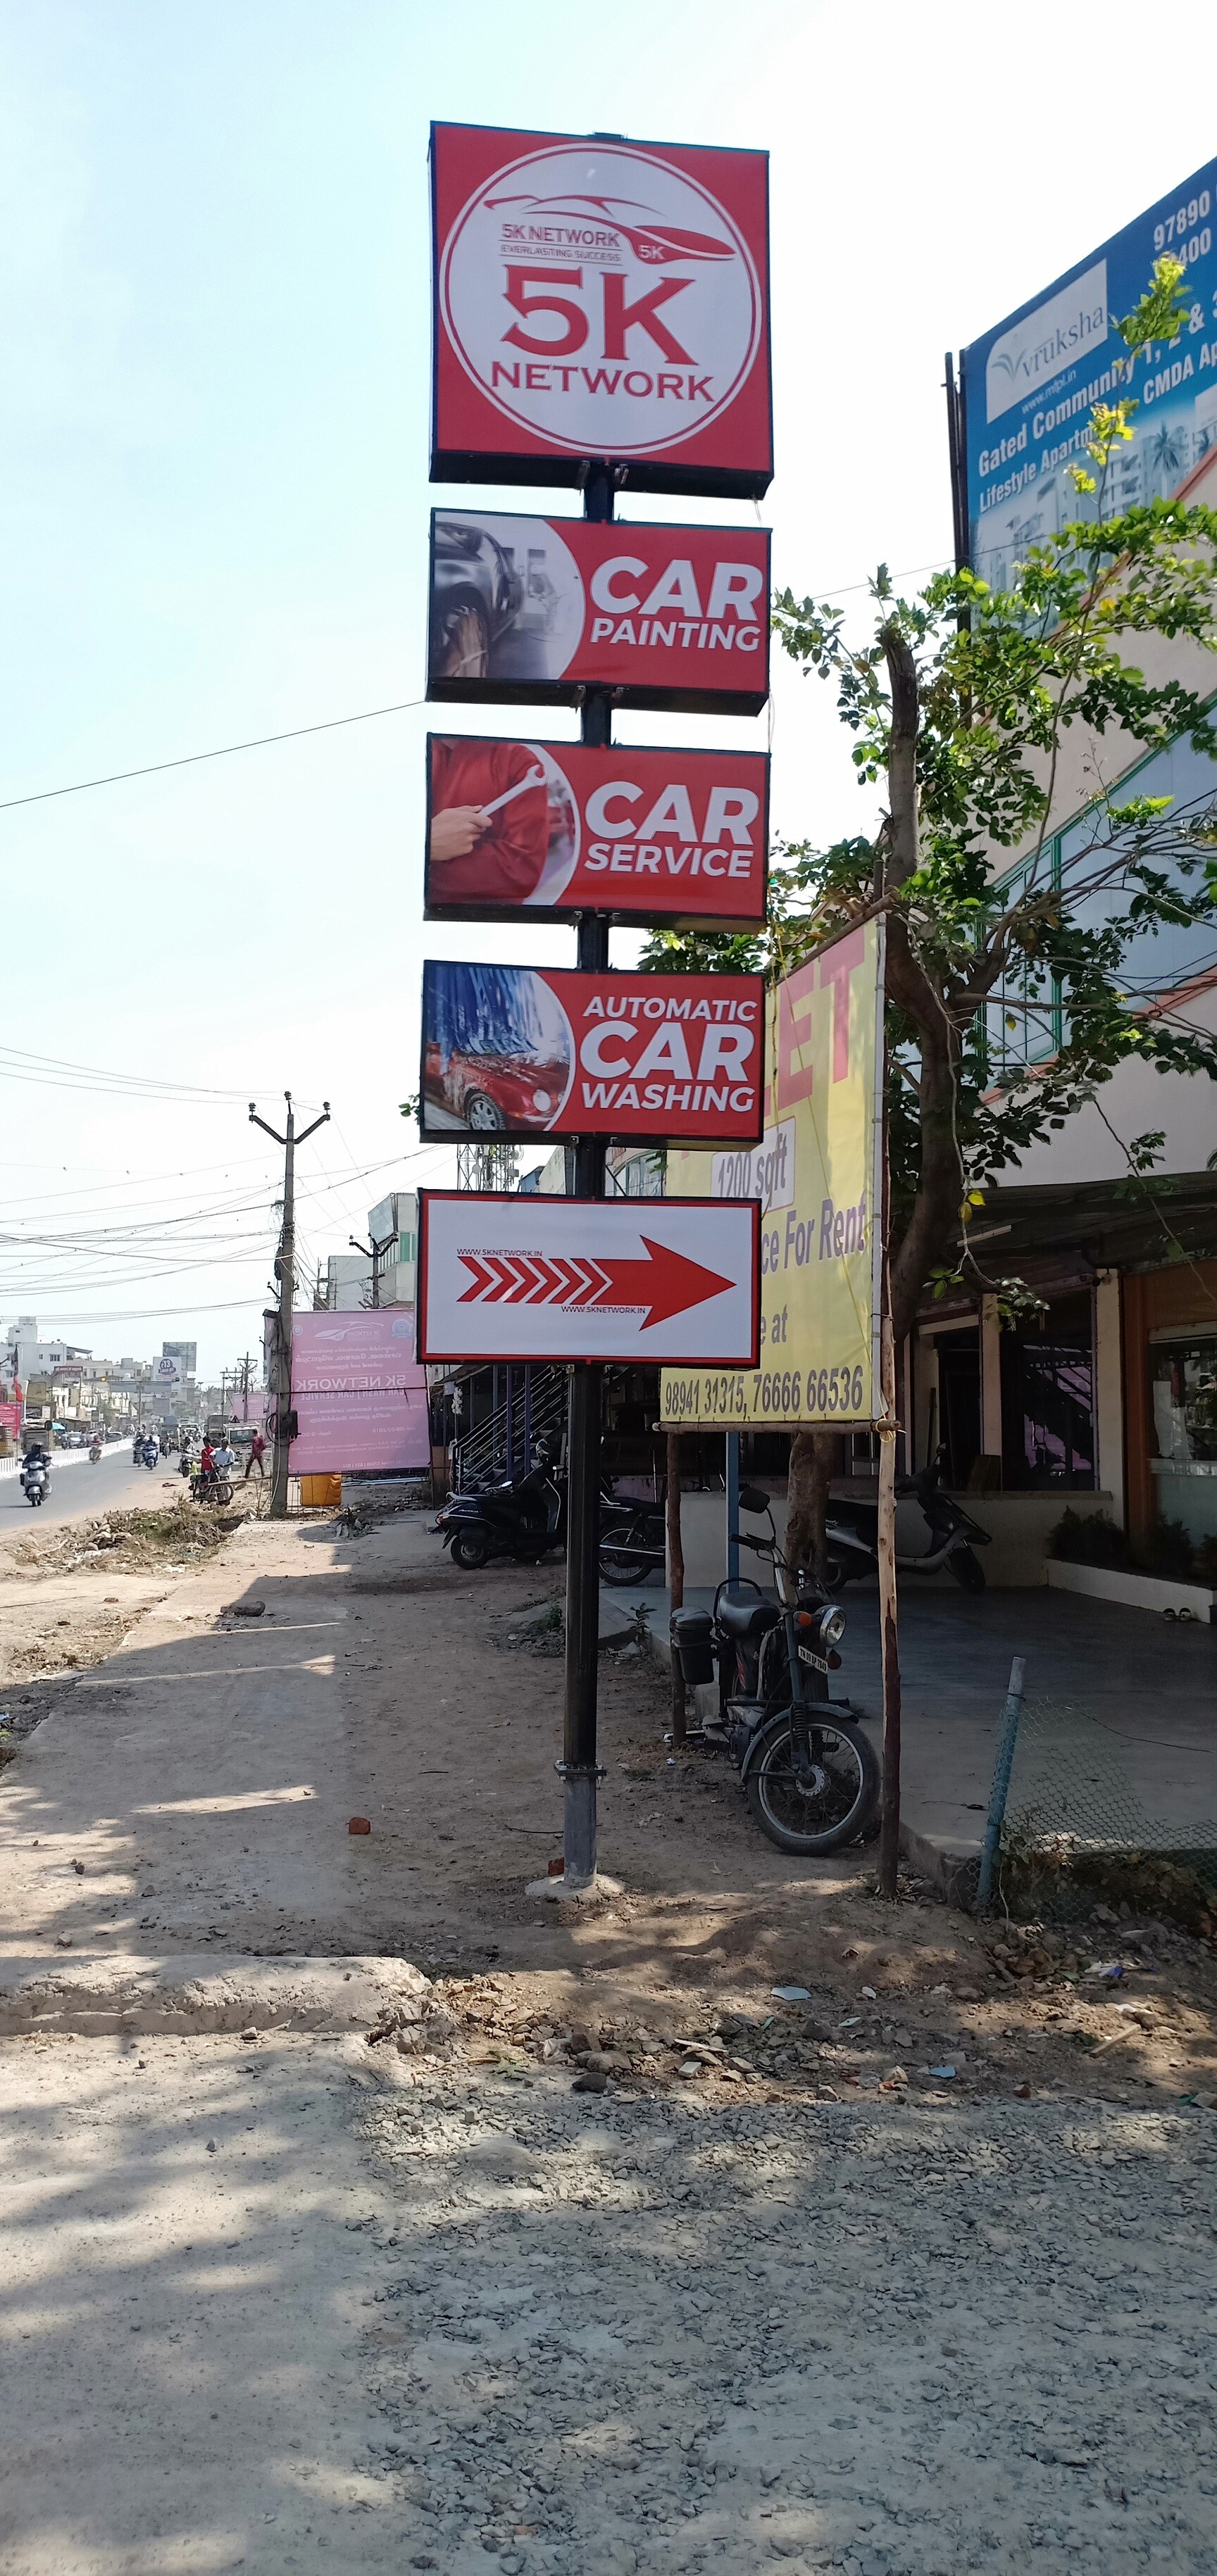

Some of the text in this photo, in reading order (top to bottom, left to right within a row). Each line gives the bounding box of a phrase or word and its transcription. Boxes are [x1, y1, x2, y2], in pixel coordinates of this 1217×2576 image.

[501, 223, 621, 246] 5K NETWORK
[1154, 189, 1211, 251] 97890
[501, 244, 621, 261] EVERLASTING SUCCESS
[638, 245, 666, 260] 5K
[500, 264, 700, 367] 5K
[492, 360, 715, 402] NETWORK
[978, 422, 1028, 477] Gated
[980, 461, 1037, 513] Lifestyle
[1143, 353, 1194, 405] CMDA
[589, 556, 763, 621] CAR
[589, 618, 761, 652] PAINTING
[585, 781, 759, 846] CAR
[585, 844, 754, 878] SERVICE
[582, 996, 759, 1022] AUTOMATIC
[777, 926, 865, 1111] ET
[580, 1020, 756, 1082] CAR
[581, 1083, 755, 1112] WASHING
[718, 1132, 787, 1207] 1200 sqft
[457, 1248, 543, 1257] WWW.5KNETWORK.IN
[784, 1210, 815, 1269] For
[819, 1190, 866, 1260] Rent
[561, 1306, 646, 1314] WWW.5KNETWORK.IN
[771, 1304, 788, 1344] at
[665, 1364, 863, 1422] 98941 31315, 76666 66536
